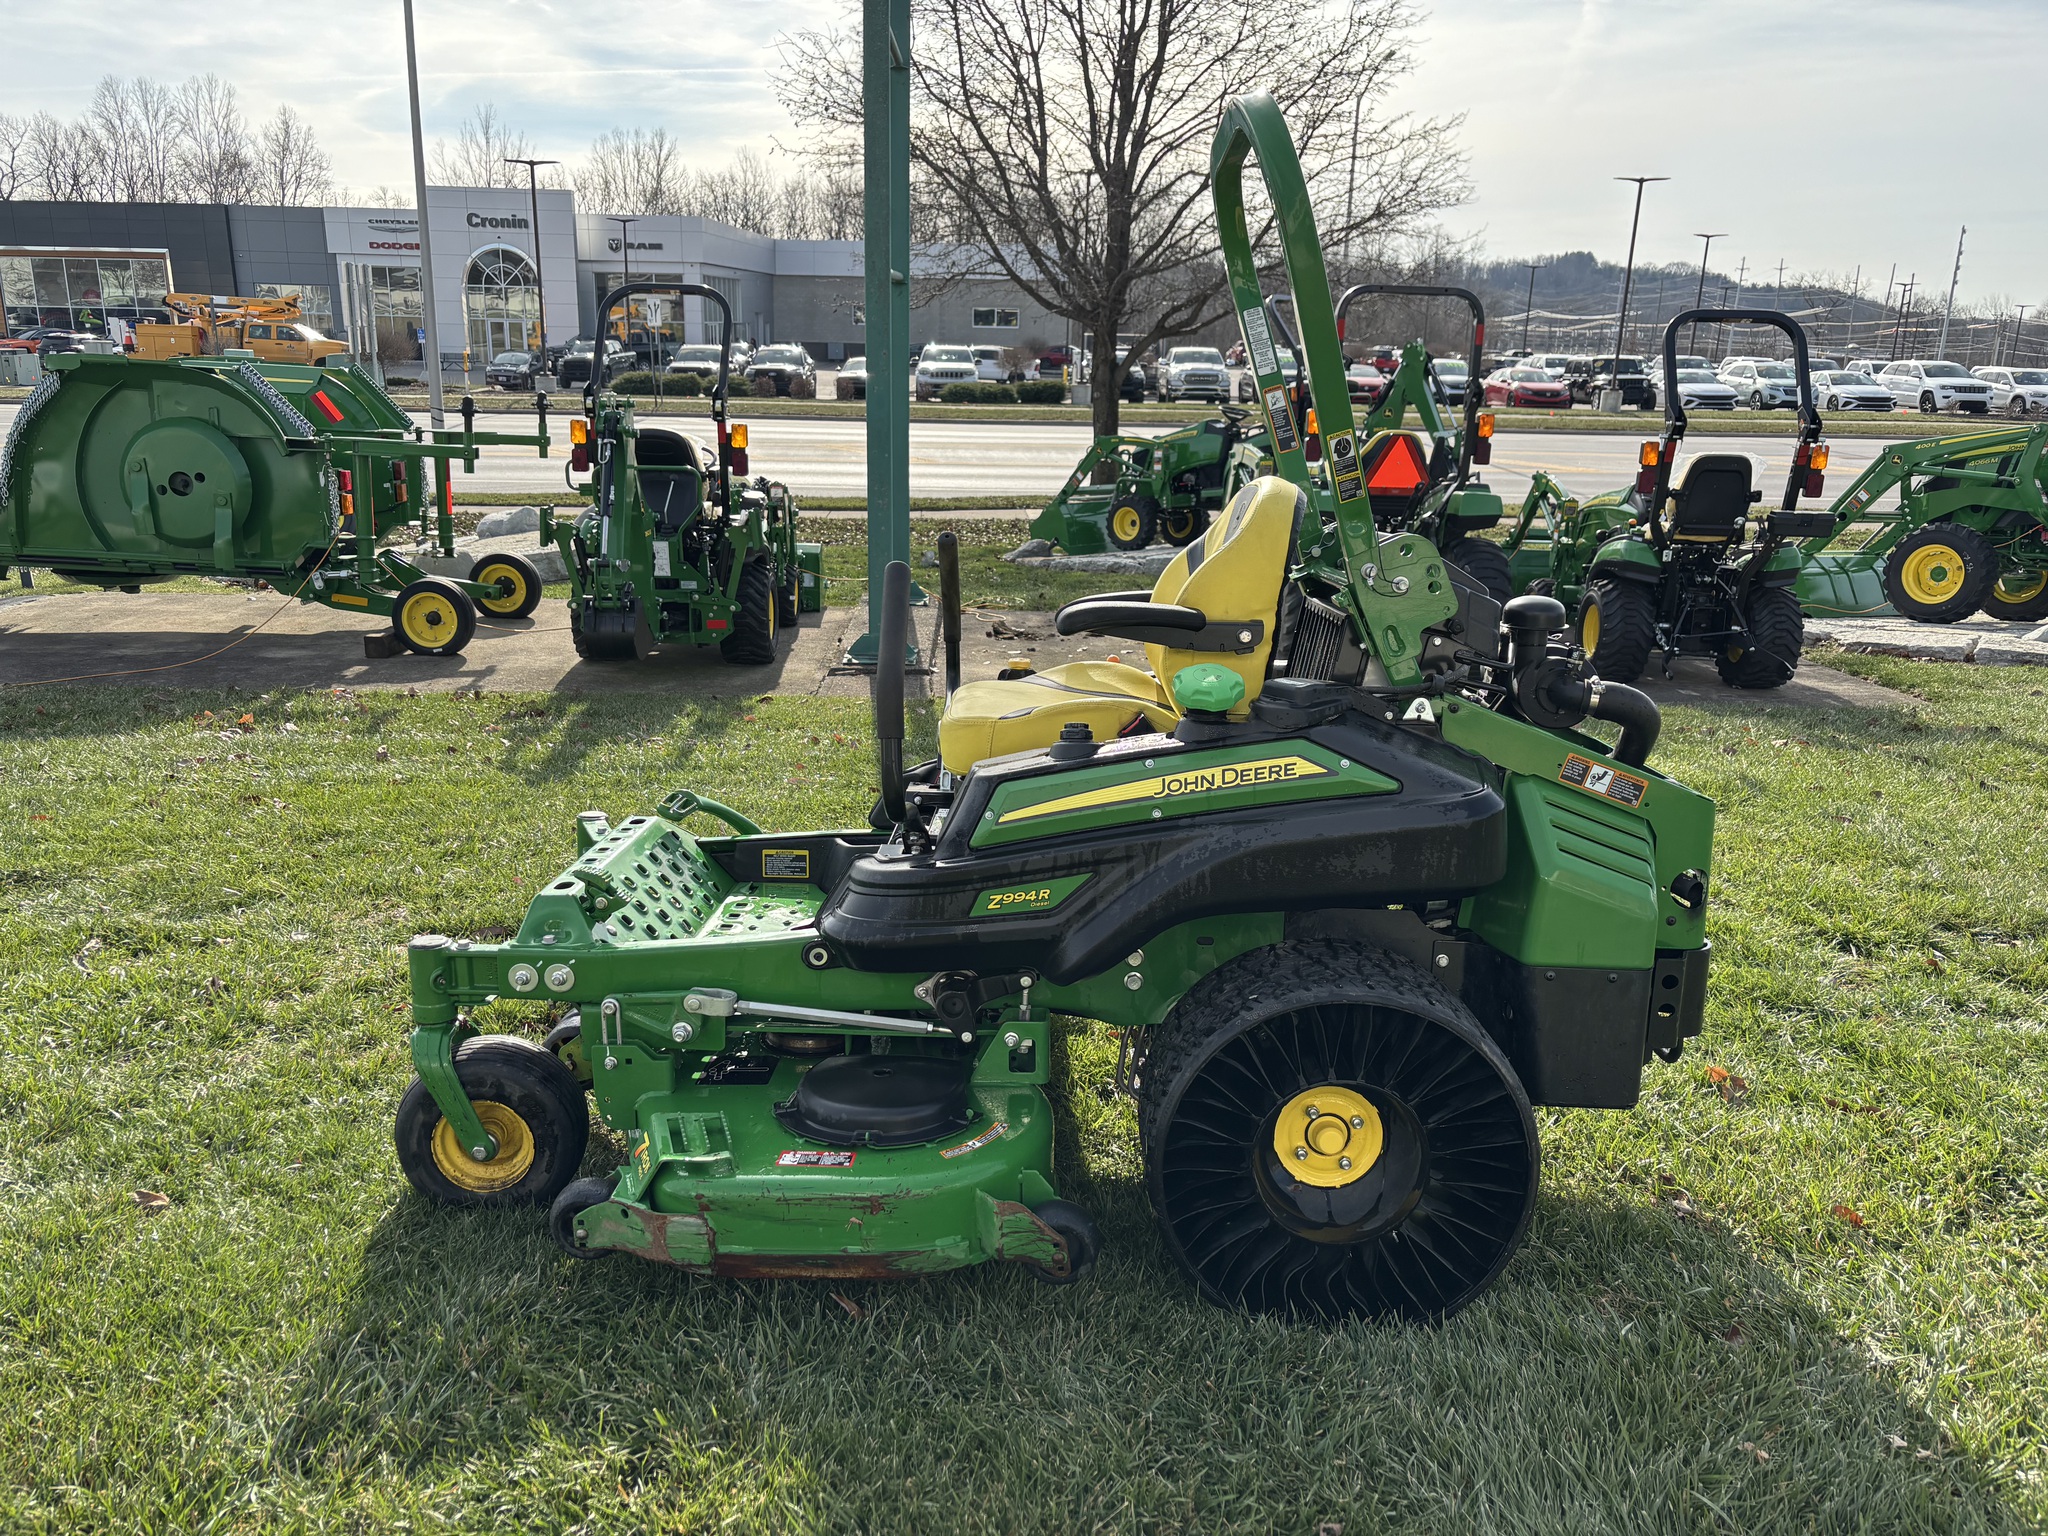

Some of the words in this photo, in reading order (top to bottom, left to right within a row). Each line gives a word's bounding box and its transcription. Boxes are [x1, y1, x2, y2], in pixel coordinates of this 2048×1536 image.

[466, 212, 529, 229] Cronin
[626, 242, 664, 250] RAM
[1968, 457, 1999, 467] 4066M
[1153, 773, 1216, 796] JOHN
[1221, 762, 1298, 786] DEERE
[987, 889, 1051, 910] Z994R
